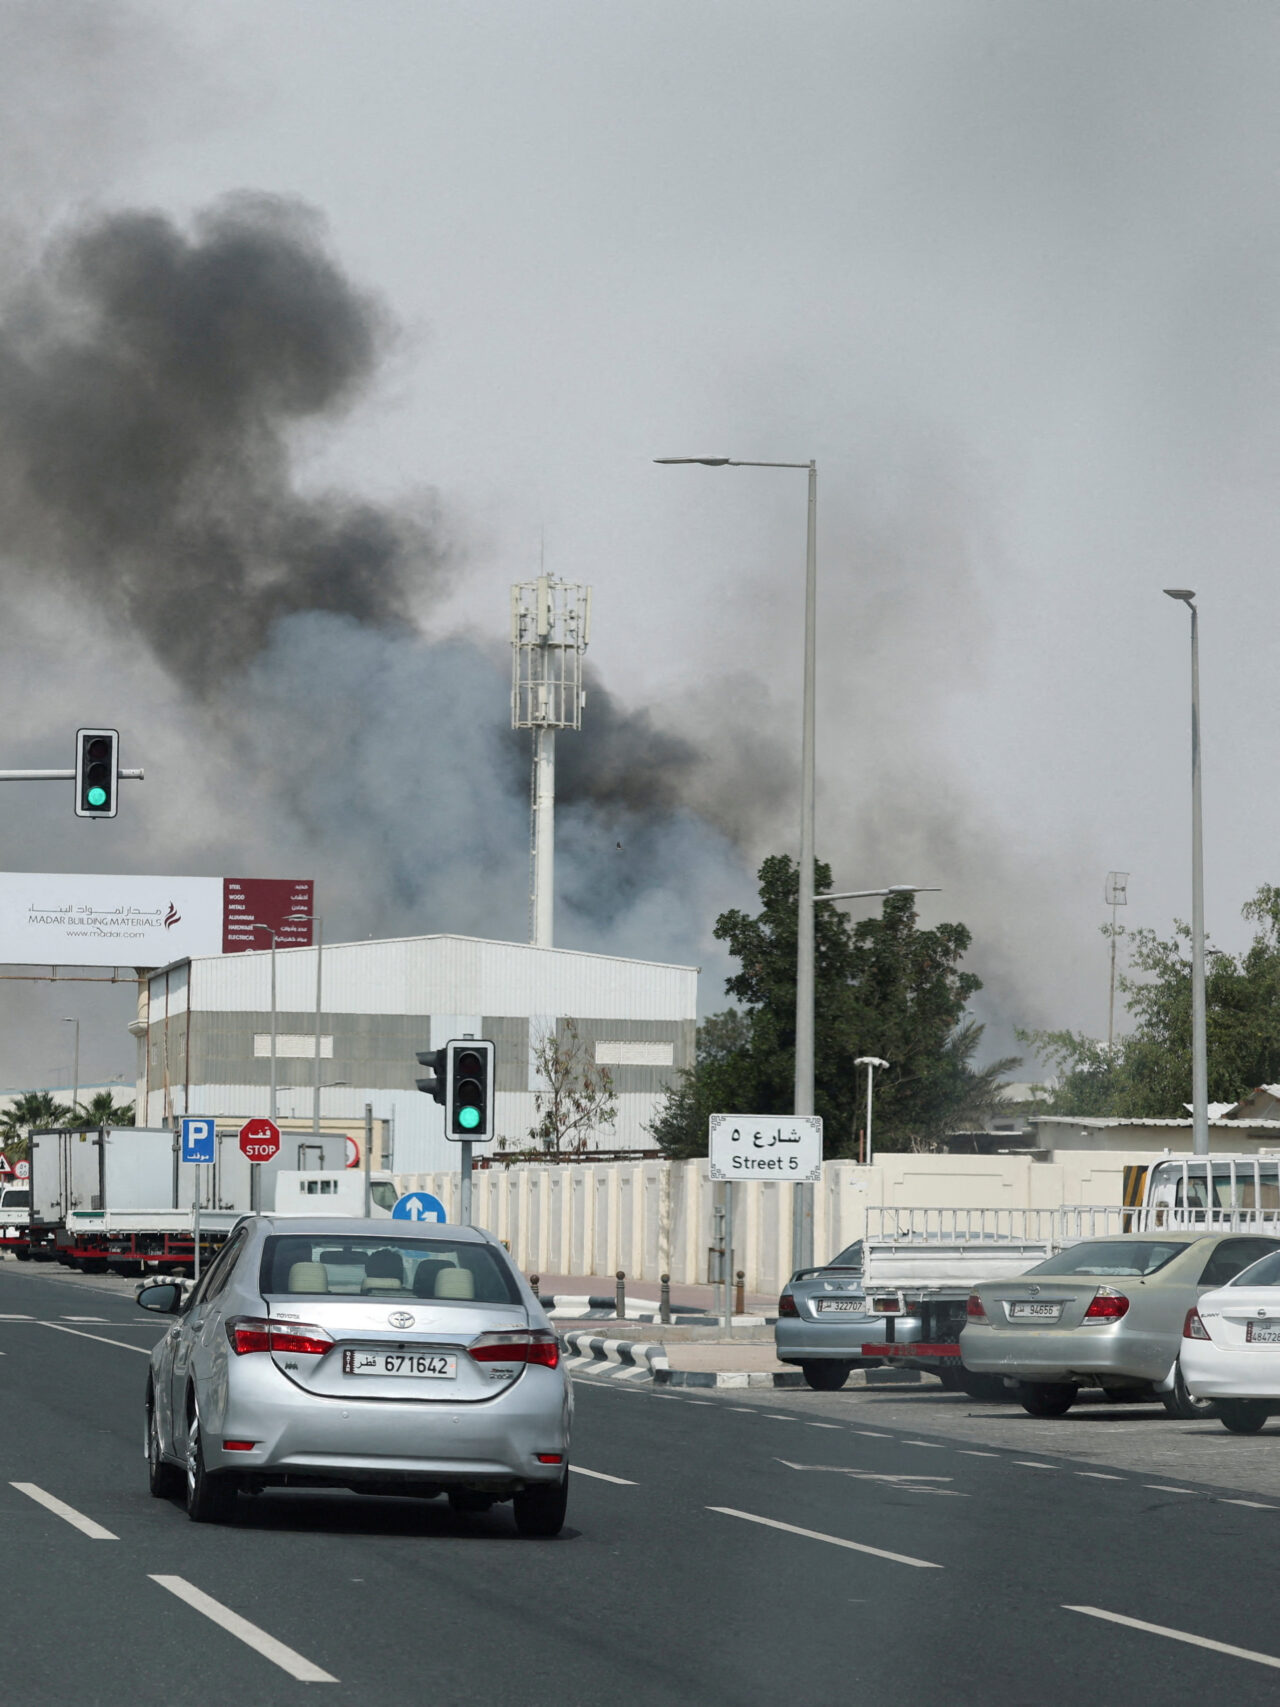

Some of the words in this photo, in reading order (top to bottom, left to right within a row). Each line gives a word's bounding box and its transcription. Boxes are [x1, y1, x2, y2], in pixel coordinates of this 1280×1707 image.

[28, 915, 65, 925] MADAR
[67, 917, 109, 927] BUILDING
[109, 917, 162, 928] MATERIALS
[66, 929, 145, 939] www.madar.com
[188, 1121, 209, 1149] P
[248, 1126, 272, 1139] قف
[731, 1128, 741, 1142] ٥
[753, 1128, 801, 1148] شارع
[186, 1152, 210, 1161] موقف
[245, 1144, 277, 1156] STOP
[732, 1155, 784, 1170] Street
[788, 1156, 799, 1170] 5
[834, 1301, 863, 1311] 322707
[1029, 1304, 1054, 1315] 94656
[355, 1355, 377, 1369] قطر
[384, 1354, 448, 1374] 671642
